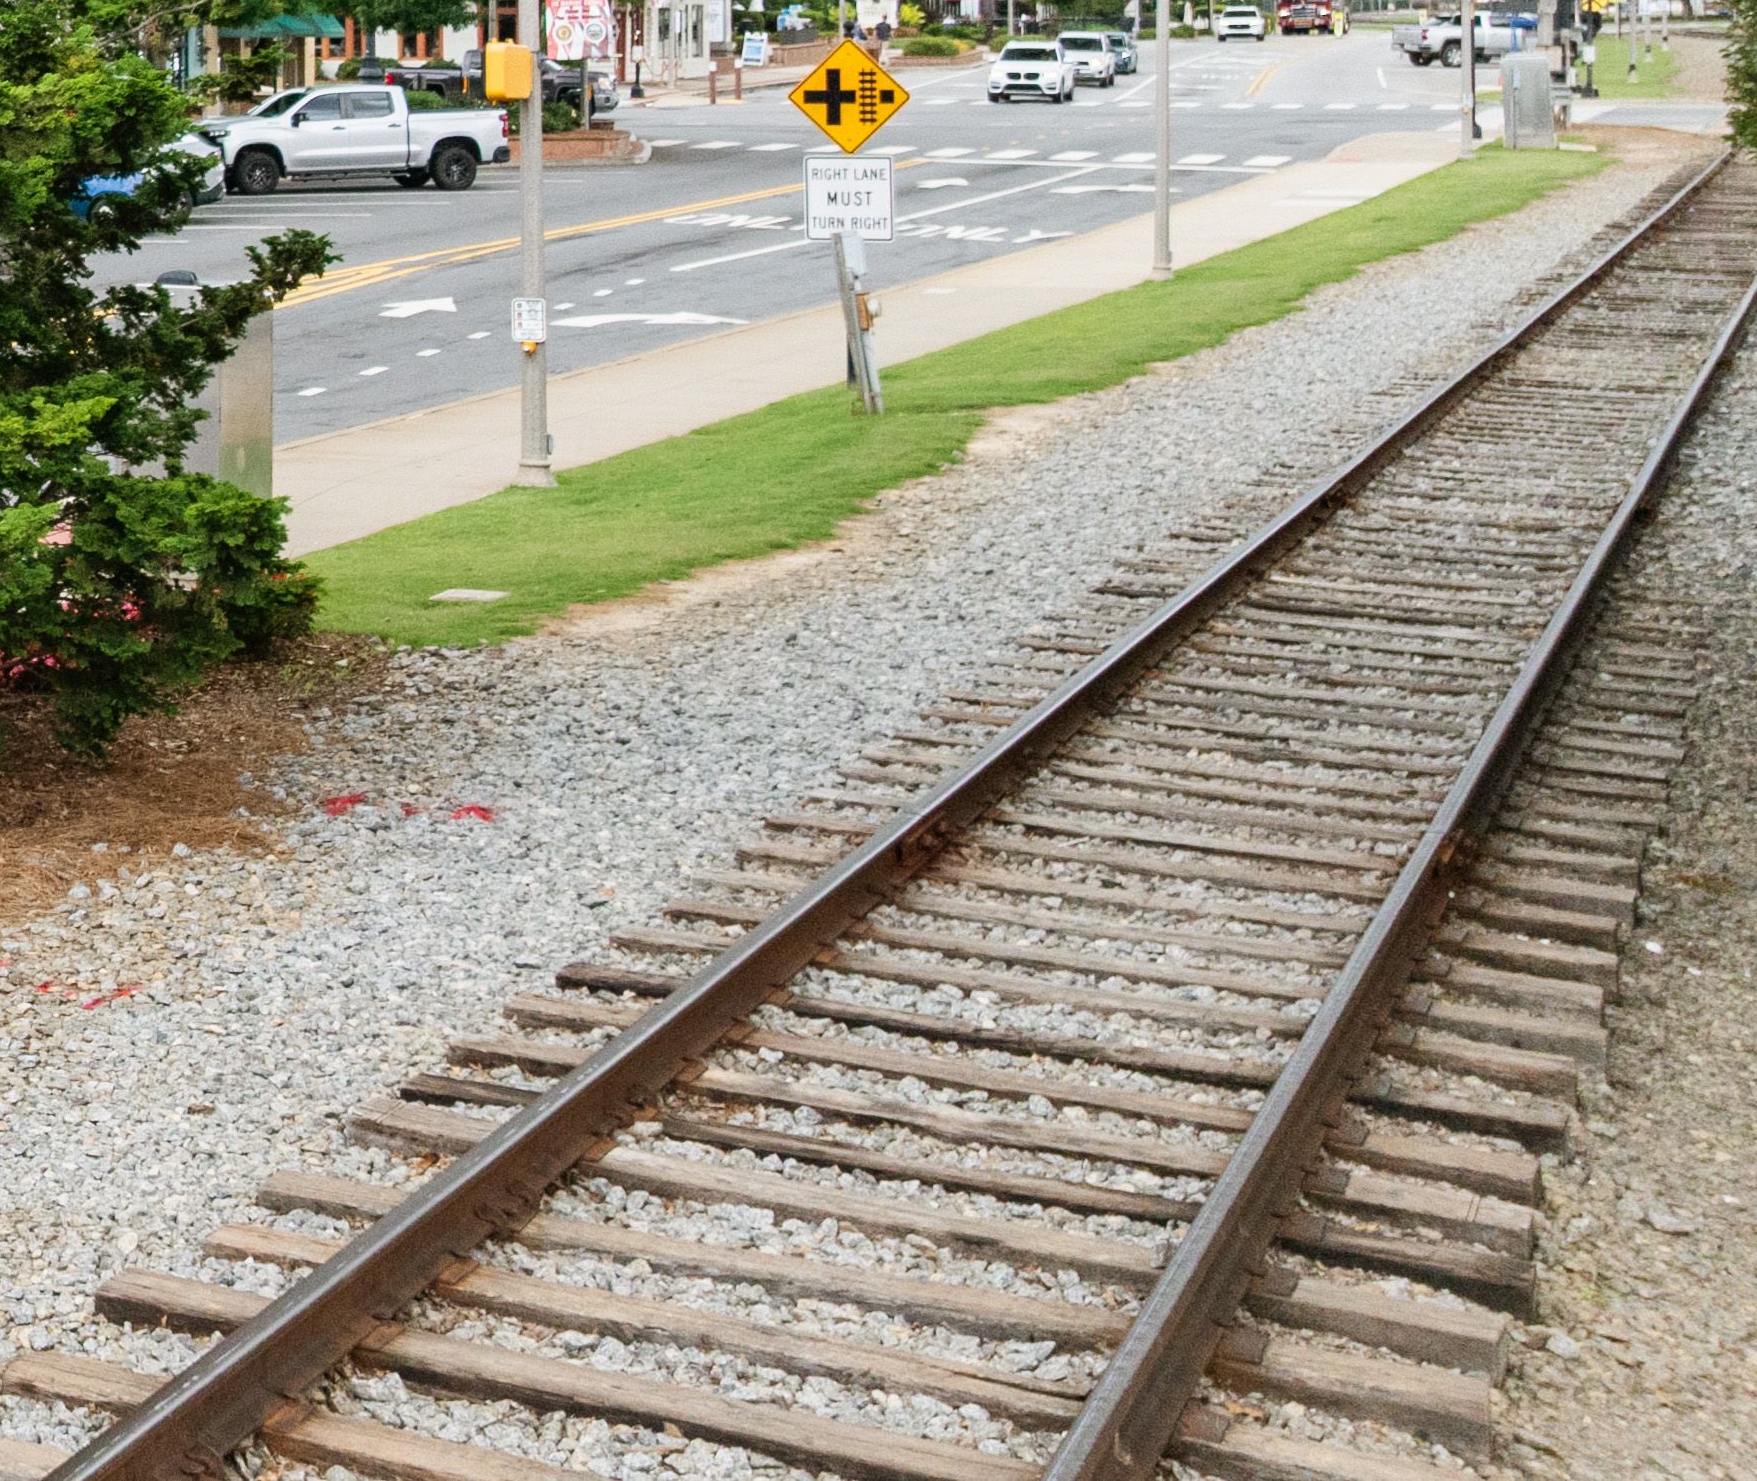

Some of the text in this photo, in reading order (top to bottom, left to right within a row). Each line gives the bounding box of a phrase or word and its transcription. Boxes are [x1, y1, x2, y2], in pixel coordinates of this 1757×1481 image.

[811, 168, 888, 181] RIGHT LANE
[827, 191, 872, 207] MUST
[812, 216, 888, 230] TURN RIGHT
